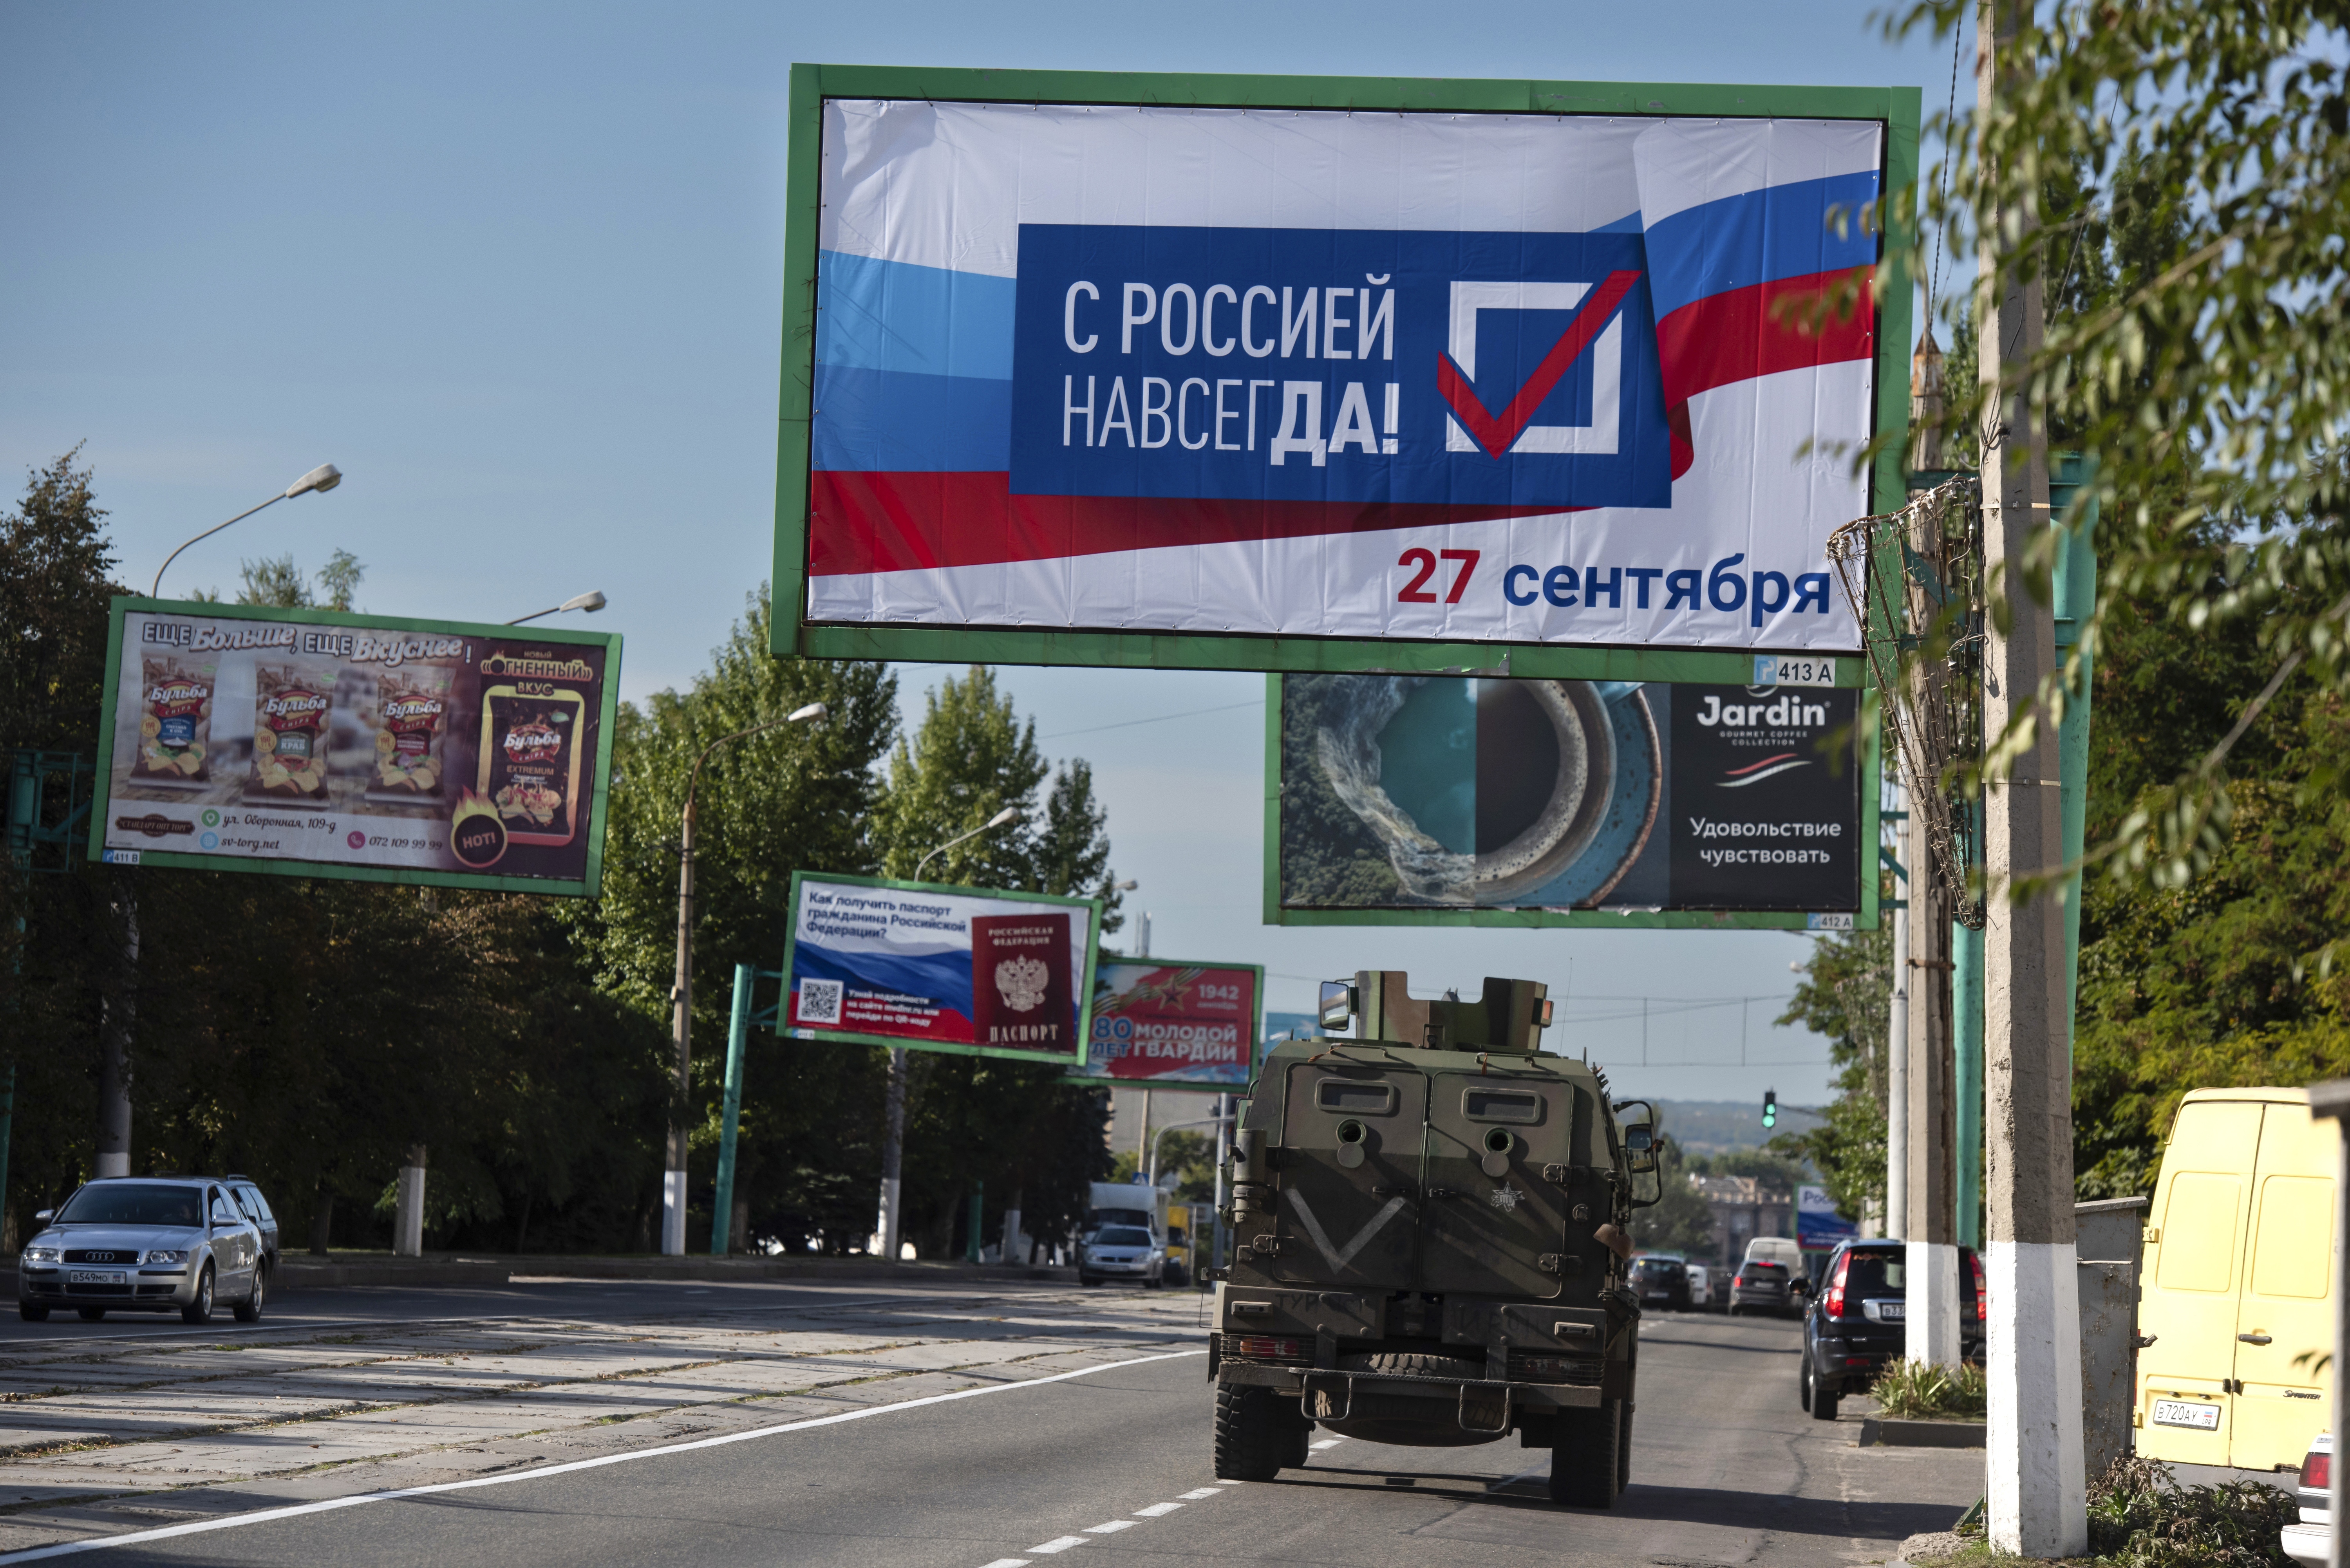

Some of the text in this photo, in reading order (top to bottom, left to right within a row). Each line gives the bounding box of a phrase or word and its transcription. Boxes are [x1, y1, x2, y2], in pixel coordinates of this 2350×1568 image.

[1064, 273, 1395, 360] С РОССИЕЙ
[1063, 375, 1399, 466] НАВСЕГДА!
[1398, 548, 1830, 627] 27 сентября
[143, 622, 472, 667] ЕЩЕ Больше, ЕЩЕ Вкуснее!
[1779, 663, 1812, 681] 413
[149, 684, 208, 704] Бульба
[516, 681, 554, 696] ВКУС
[165, 706, 191, 715] CHIPS
[264, 695, 326, 716] Бульба
[384, 700, 442, 719] Бульба
[1697, 695, 1825, 726] Jardin
[282, 718, 309, 728] CHIPS
[400, 720, 425, 730] CHIPS
[503, 731, 560, 750] Бульба
[519, 752, 544, 761] CHIPS
[507, 765, 554, 775] EXTREMUM
[156, 822, 170, 831] ОПТ
[222, 815, 239, 828] ул.
[244, 814, 304, 830] Оборонная,
[1690, 817, 1842, 838] Удовольствие
[221, 838, 279, 853] sv-torg.net
[369, 836, 442, 850] 072 109 99 99
[462, 832, 496, 849] HOT!
[114, 851, 128, 862] 411
[1700, 850, 1830, 867] чувствовать
[809, 892, 951, 918] Как получить паспорт
[807, 908, 966, 932] гражданина Российской
[1822, 917, 1840, 927] 412
[806, 922, 886, 938] Федерации?
[988, 927, 1054, 936] РОССИЙСКАЯ
[992, 936, 1050, 946] ФЕДЕРАЦИЯ
[848, 989, 929, 1005] Узнай подробности
[1198, 984, 1238, 1000] 1942
[859, 1001, 883, 1011] сайте
[1197, 1001, 1238, 1010] сентябрь
[846, 1011, 882, 1022] перейди
[895, 1014, 931, 1028] QR-коду
[1093, 1015, 1133, 1040] 80
[990, 1024, 1058, 1042] ПАСПОРТ
[1136, 1023, 1237, 1042] МОЛОДОЙ
[1090, 1042, 1132, 1056] ЛЕТ
[1134, 1042, 1237, 1062] ГВАРДИИ
[73, 1273, 107, 1282] В549МО
[2158, 1404, 2198, 1422] В720АУ
